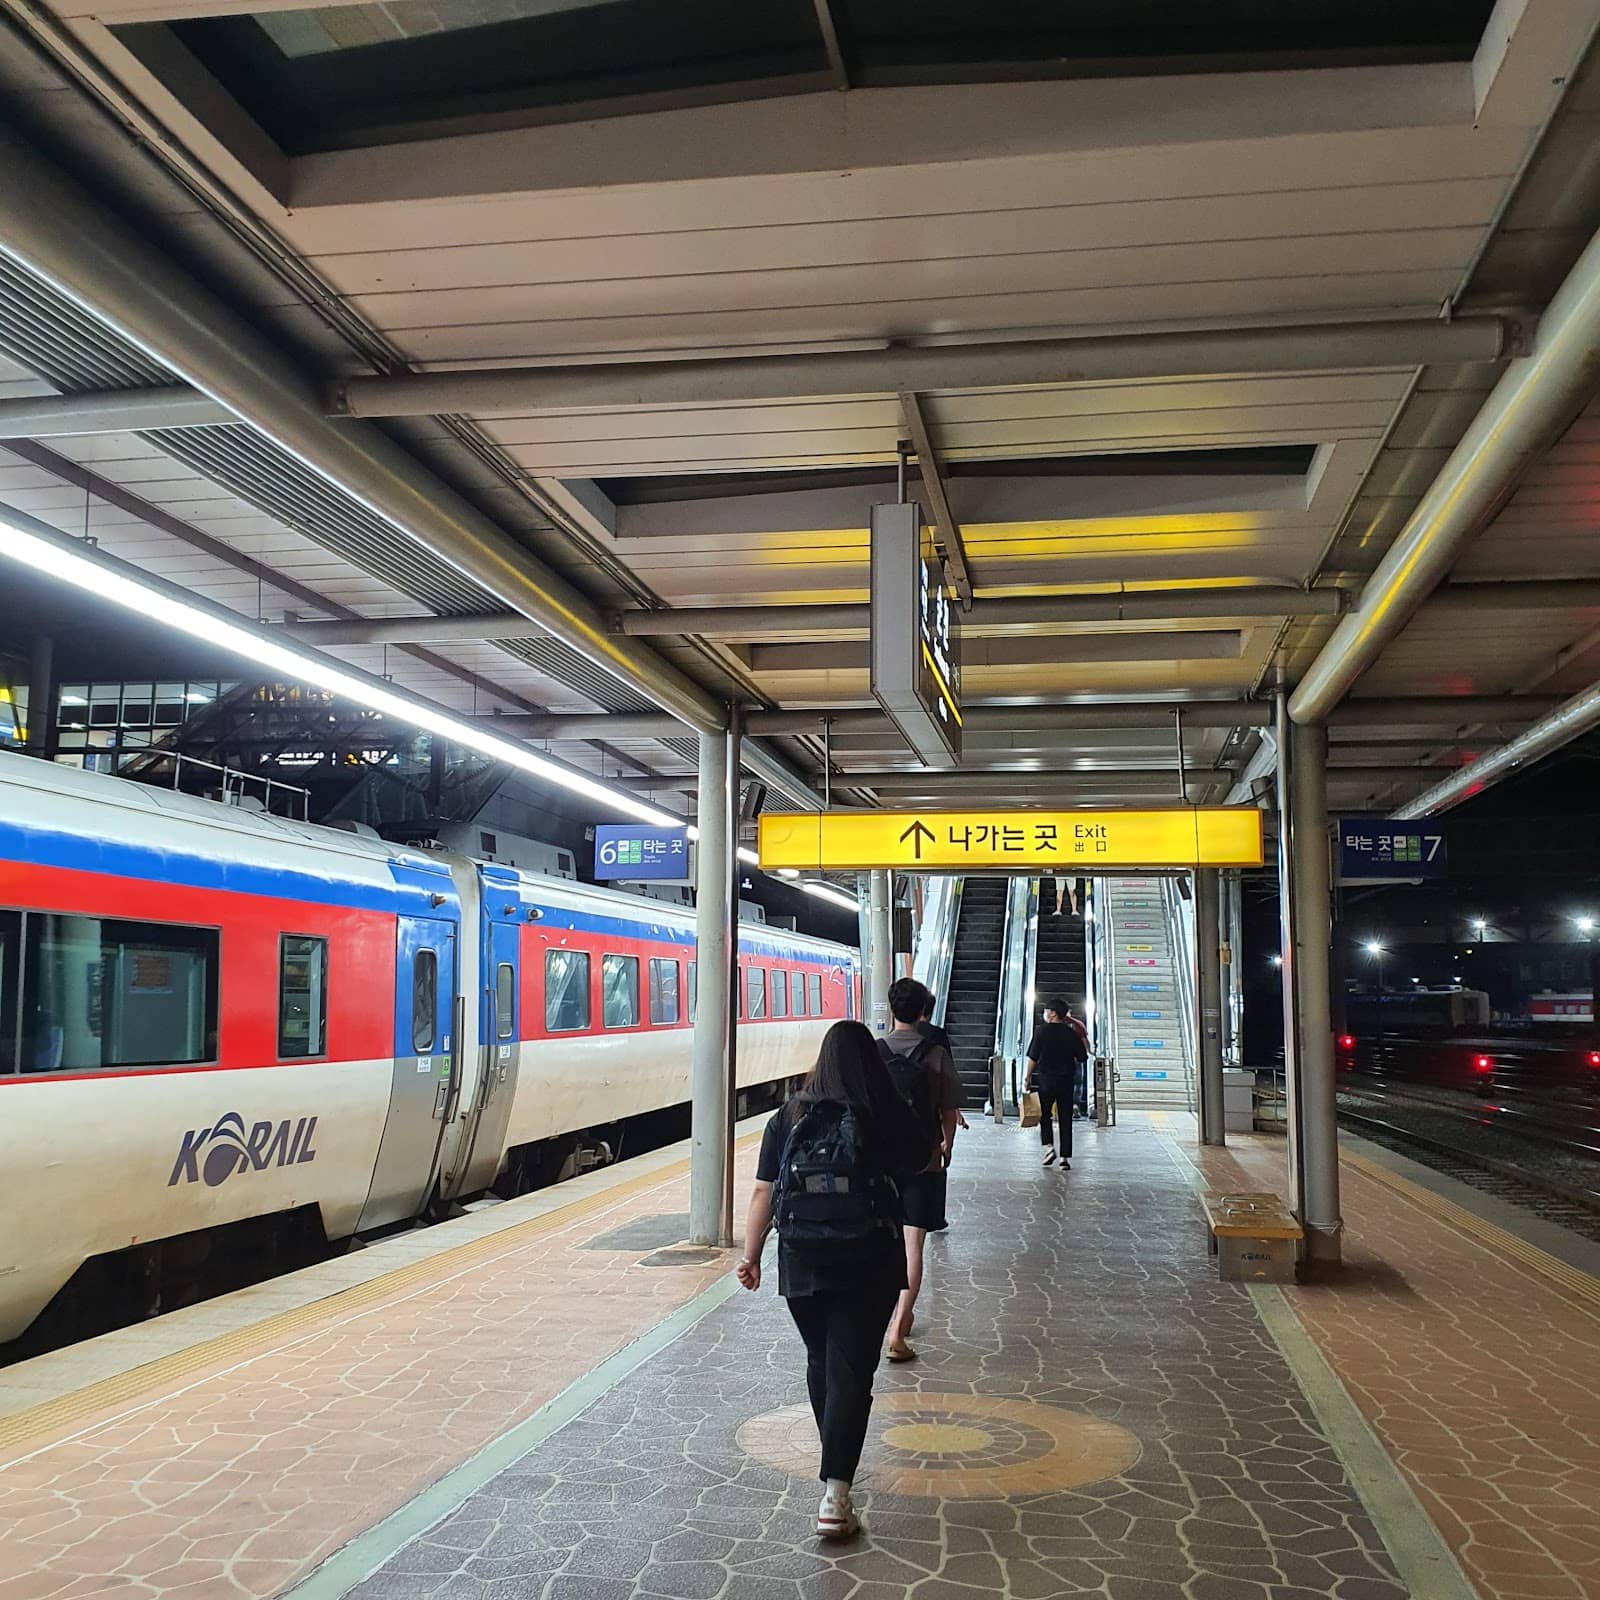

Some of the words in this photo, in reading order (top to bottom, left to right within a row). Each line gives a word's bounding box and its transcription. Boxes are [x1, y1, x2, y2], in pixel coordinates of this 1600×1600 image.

[949, 825, 1025, 851] 나가는
[1034, 825, 1058, 851] 곳
[1074, 824, 1107, 838] Exit
[600, 840, 617, 865] 6
[643, 839, 667, 854] 타는
[671, 839, 683, 854] 곳
[1074, 840, 1107, 852] 出口
[1345, 835, 1373, 851] 타는
[1378, 835, 1392, 851] 곳
[1423, 835, 1442, 862] 7
[167, 1111, 319, 1188] KORAIL
